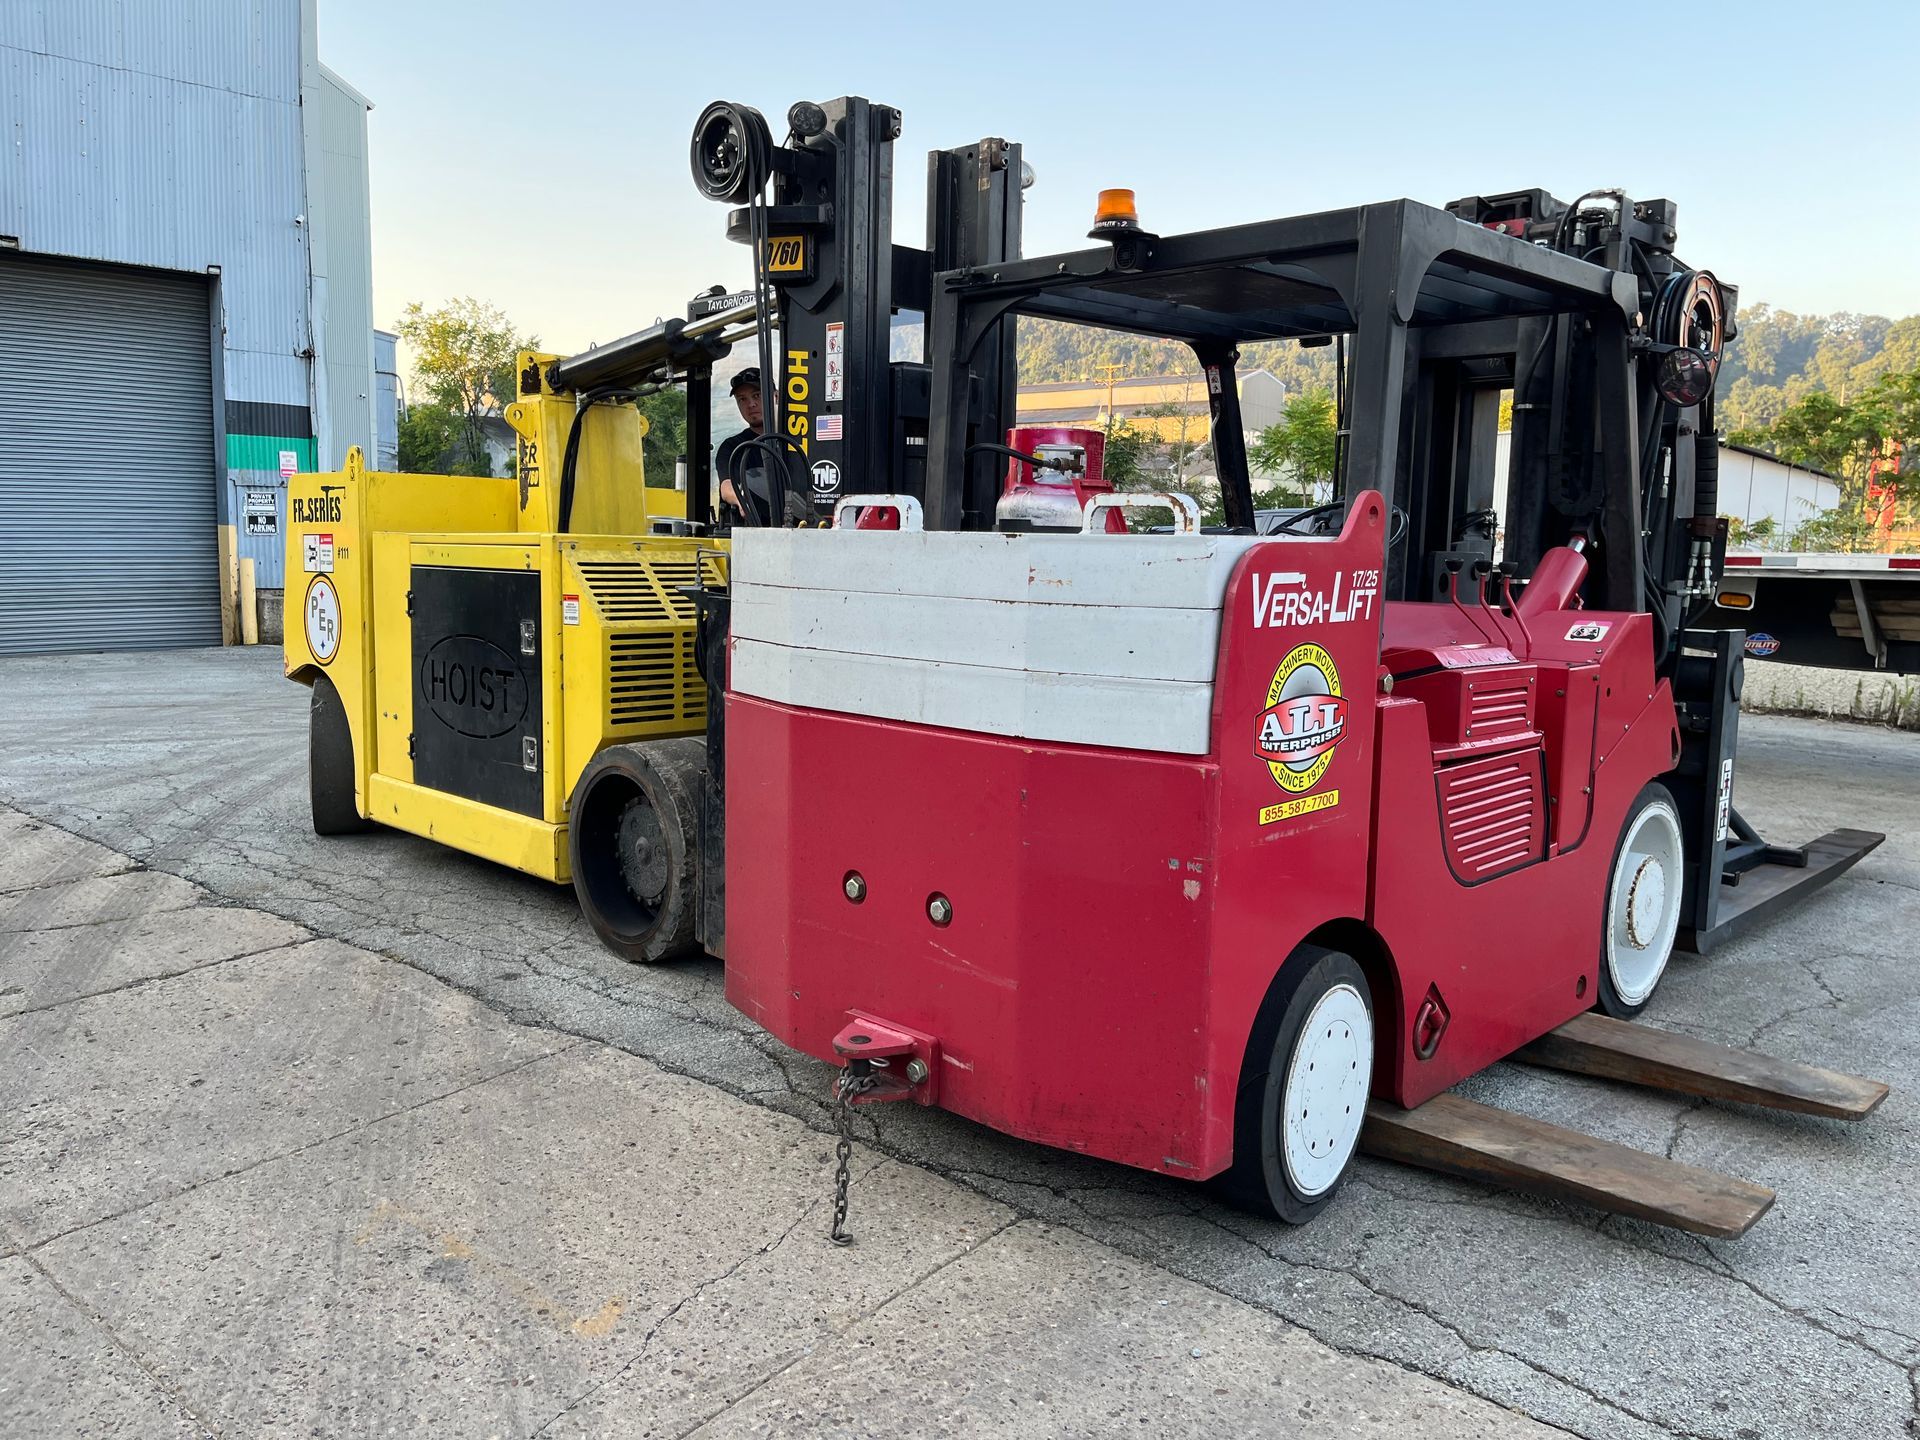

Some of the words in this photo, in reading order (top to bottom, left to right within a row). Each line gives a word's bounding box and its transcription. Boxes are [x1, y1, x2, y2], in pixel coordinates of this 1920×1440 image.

[788, 350, 808, 457] HOIST
[813, 465, 837, 487] TNE
[257, 516, 267, 524] NO
[293, 498, 304, 522] FR
[250, 524, 276, 533] PARKING
[1352, 569, 1379, 588] 17/25
[1251, 571, 1378, 629] VERSA-LIFT
[311, 596, 335, 642] PER
[1744, 641, 1778, 649] UTILITY
[430, 658, 515, 714] HOIST
[1270, 647, 1314, 702] MACHINERY
[1314, 649, 1339, 693] MOVING
[1258, 703, 1344, 741] ALL
[1261, 726, 1342, 752] ENTERPRISES
[1278, 767, 1305, 788] SINCE
[1306, 758, 1327, 784] 1975
[1264, 792, 1336, 822] 855-587-7700
